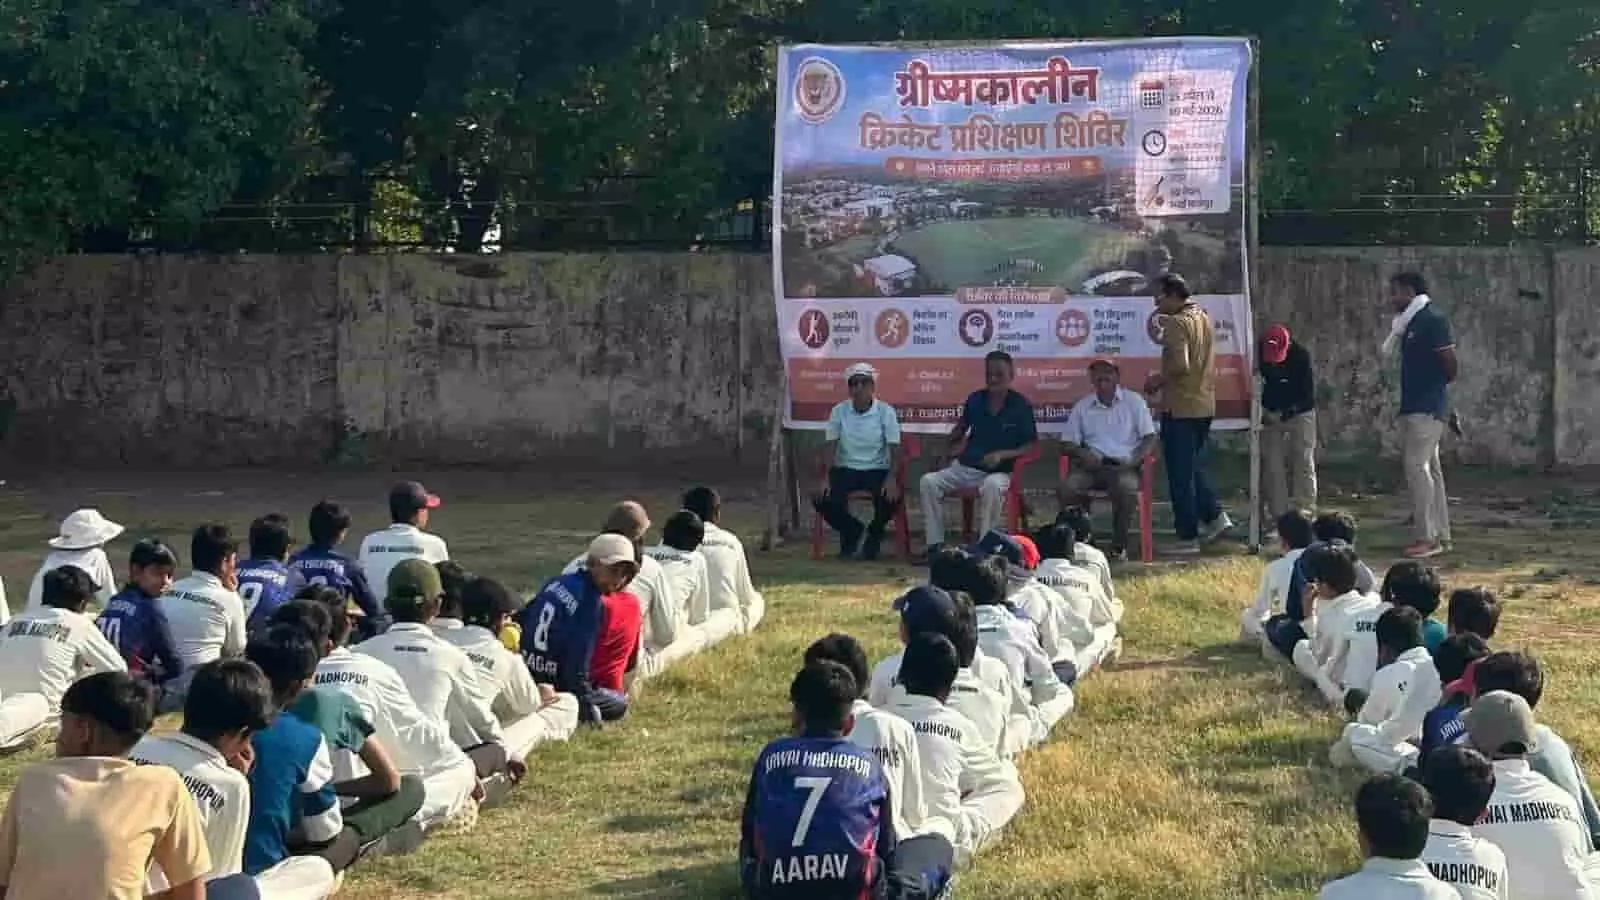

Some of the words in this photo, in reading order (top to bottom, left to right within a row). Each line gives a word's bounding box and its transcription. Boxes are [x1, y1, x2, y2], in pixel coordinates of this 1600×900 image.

[895, 57, 1100, 108] ग्रीष्मकालीन
[859, 112, 943, 151] क्रिकेट
[949, 114, 1048, 153] प्रशिक्षण
[1053, 109, 1128, 149] शिविर
[534, 602, 556, 652] 8
[791, 776, 832, 847] 7
[771, 853, 849, 884] AARAV
